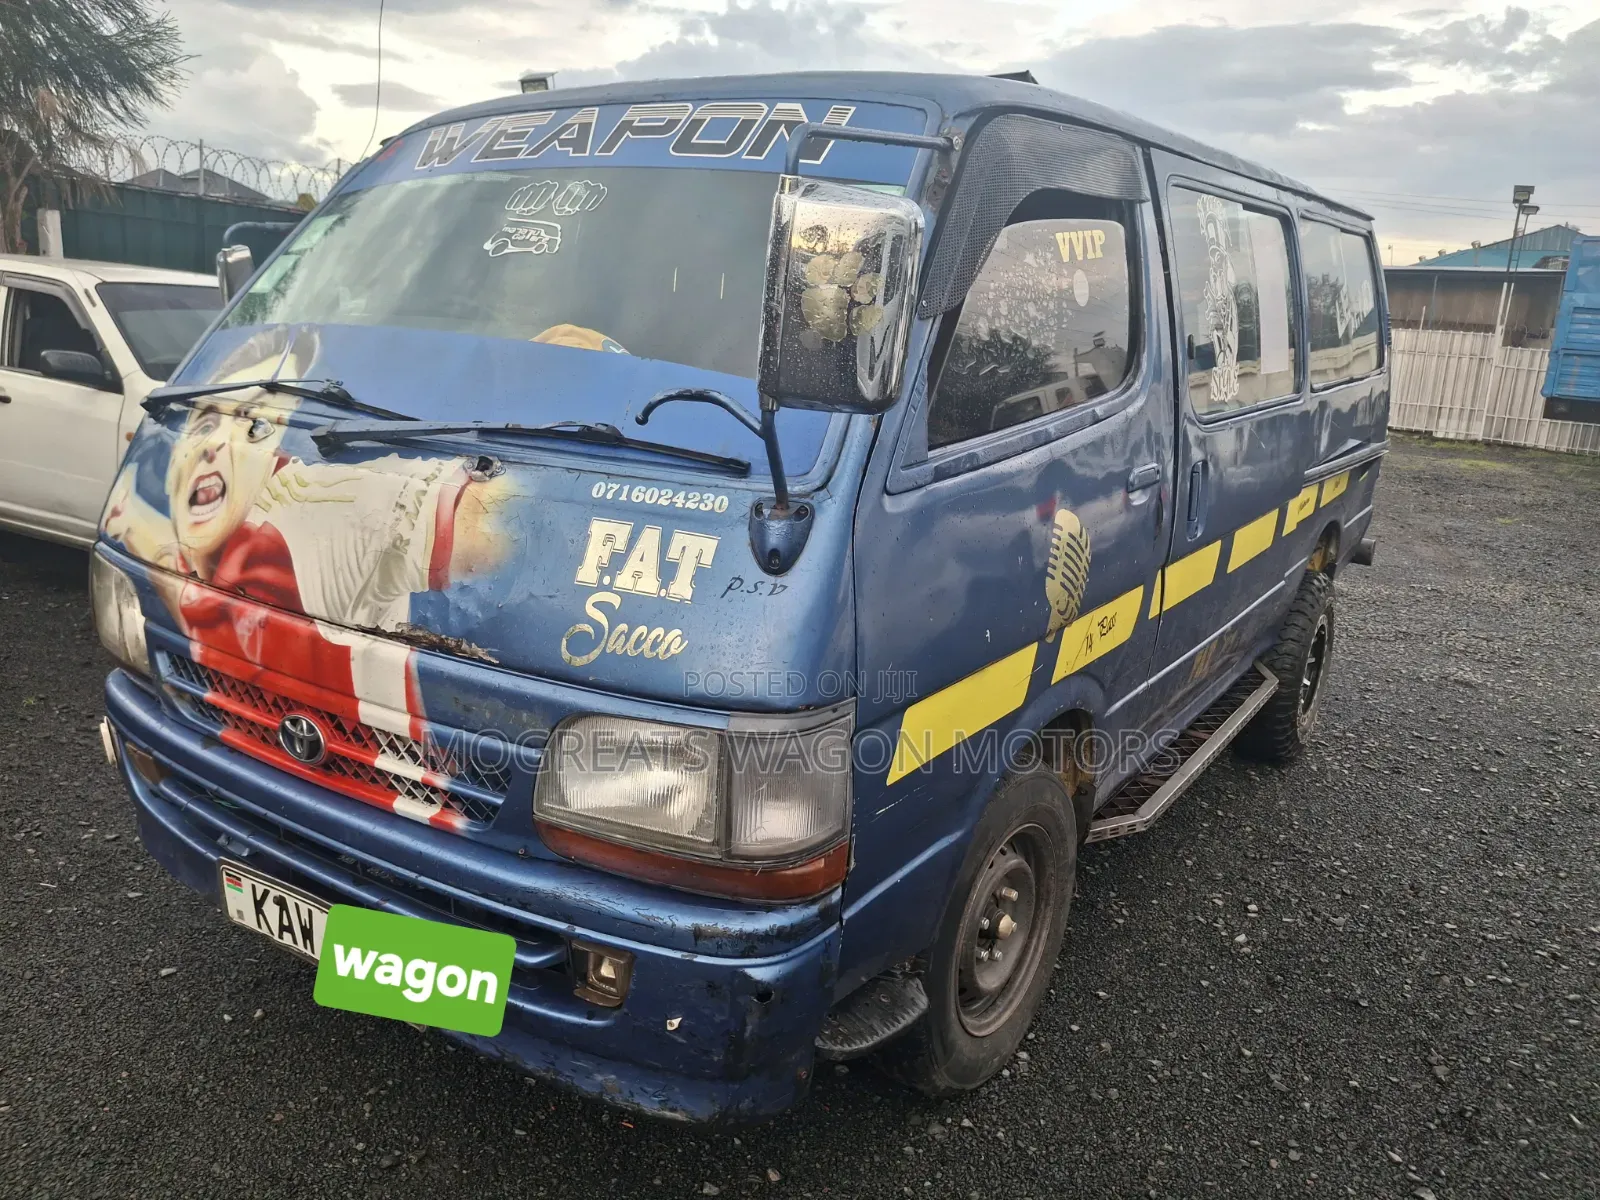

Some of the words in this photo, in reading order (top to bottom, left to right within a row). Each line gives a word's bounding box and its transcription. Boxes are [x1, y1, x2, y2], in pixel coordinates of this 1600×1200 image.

[415, 102, 856, 170] WEAPON
[1055, 229, 1106, 263] VVIP
[591, 481, 729, 513] 0716024230
[574, 517, 721, 605] F.A.T
[561, 591, 689, 667] Sacco
[250, 883, 316, 955] KAW
